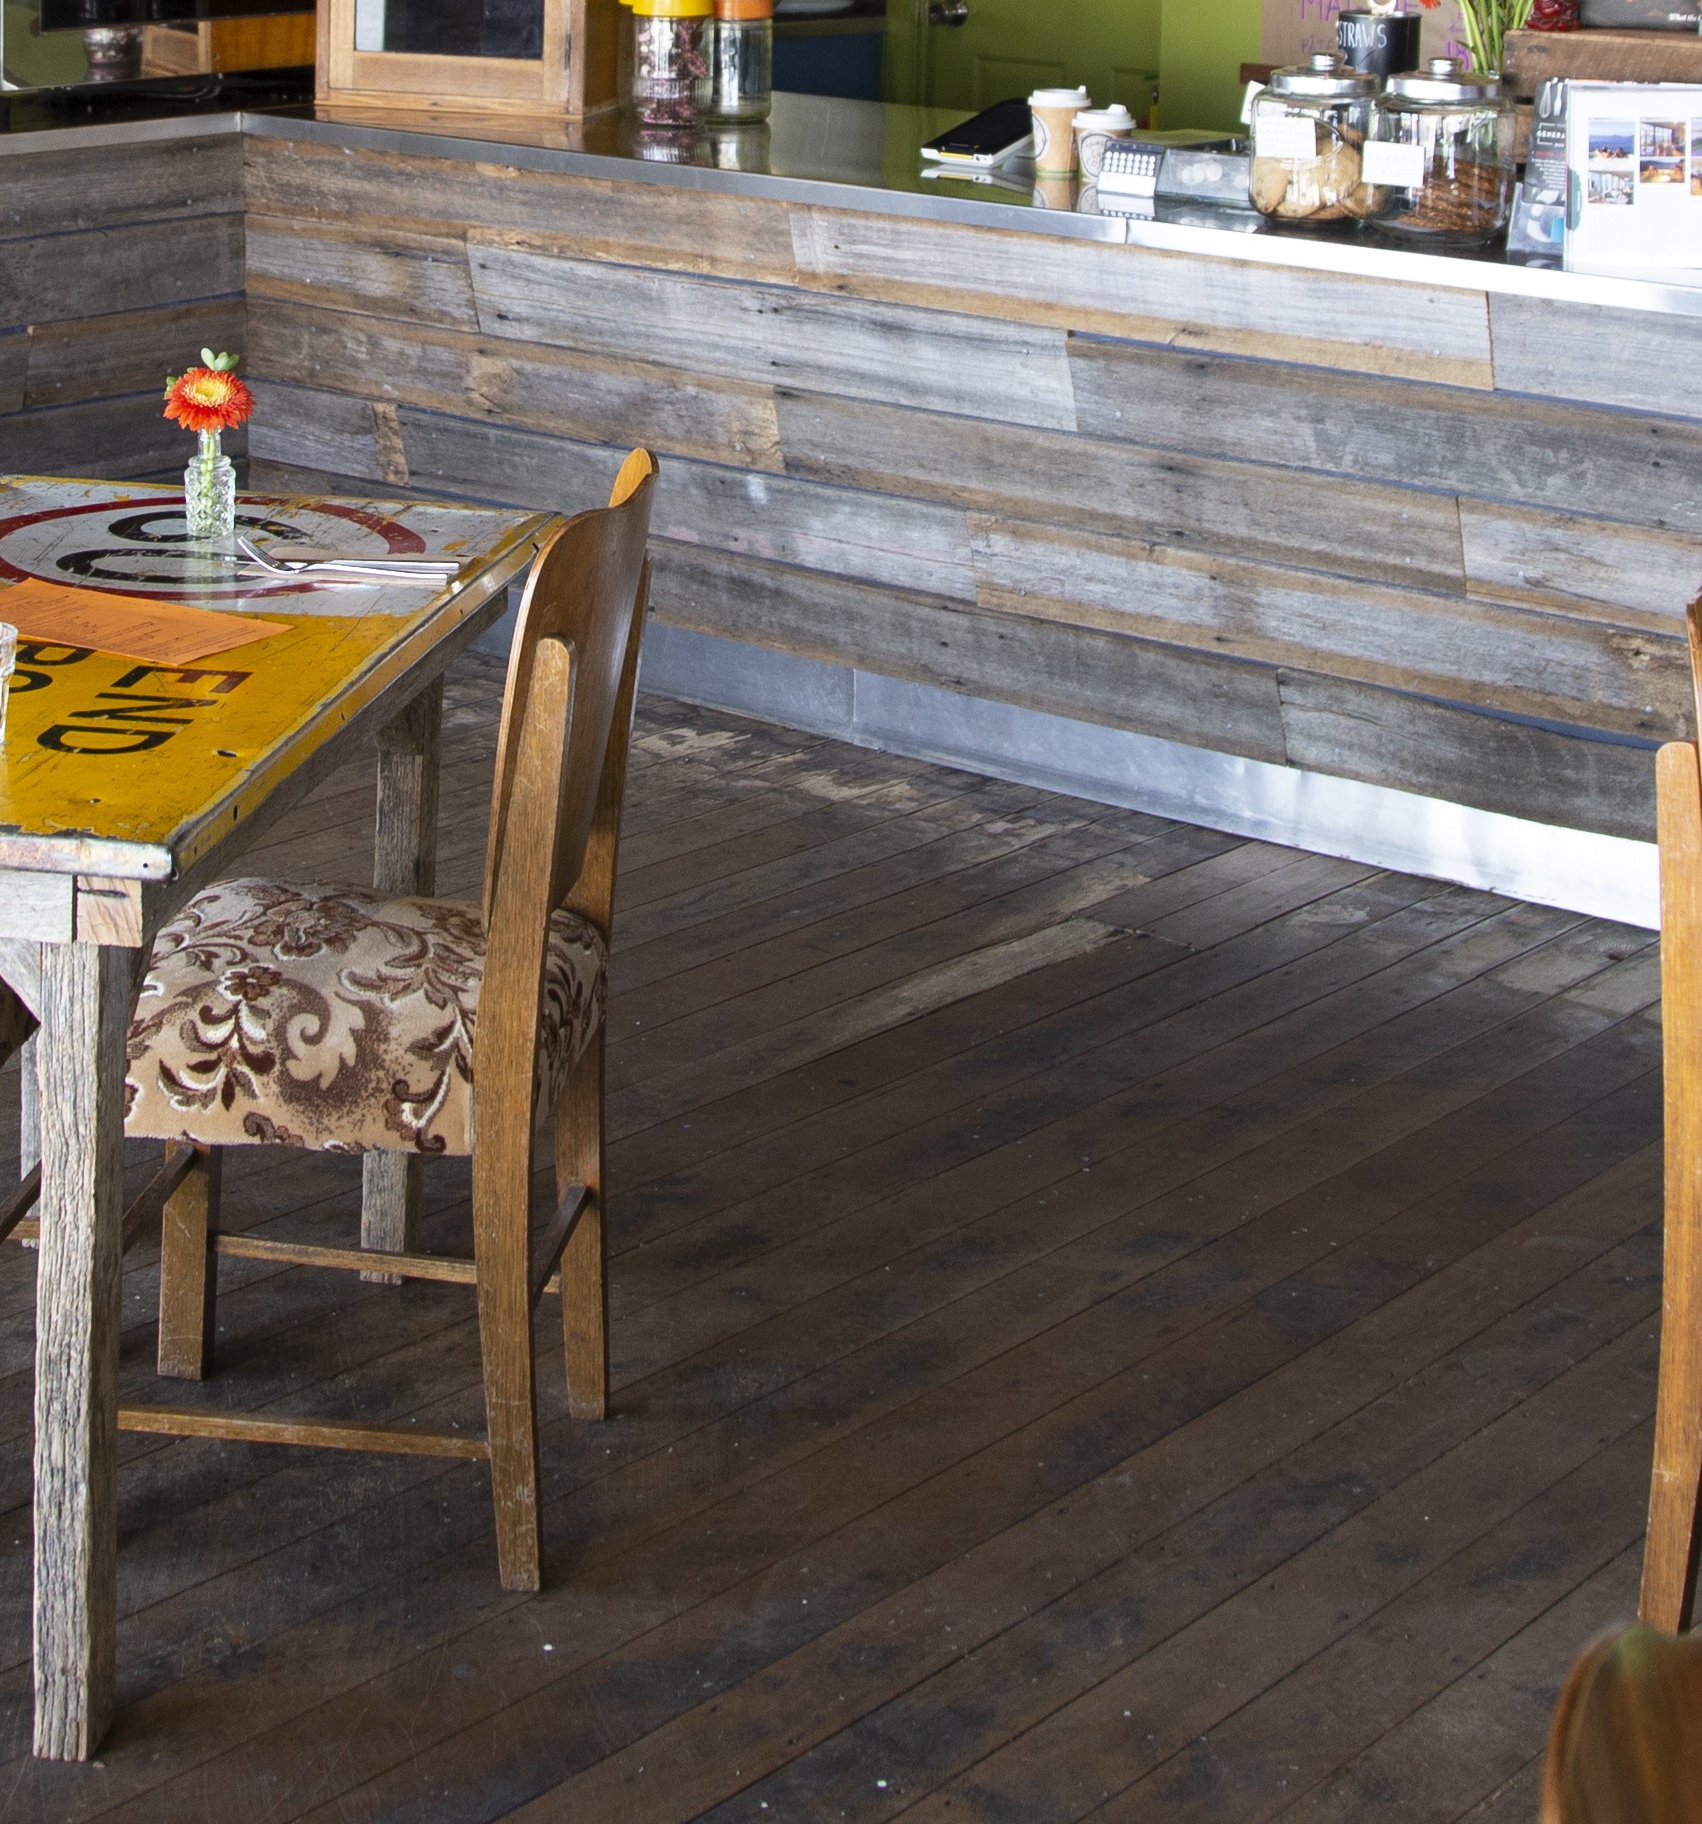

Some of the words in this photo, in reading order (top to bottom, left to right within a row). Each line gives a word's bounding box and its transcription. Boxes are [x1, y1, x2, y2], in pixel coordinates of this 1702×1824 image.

[1338, 20, 1388, 49] STRAWS
[1536, 129, 1566, 140] GENERA
[36, 665, 254, 756] END
